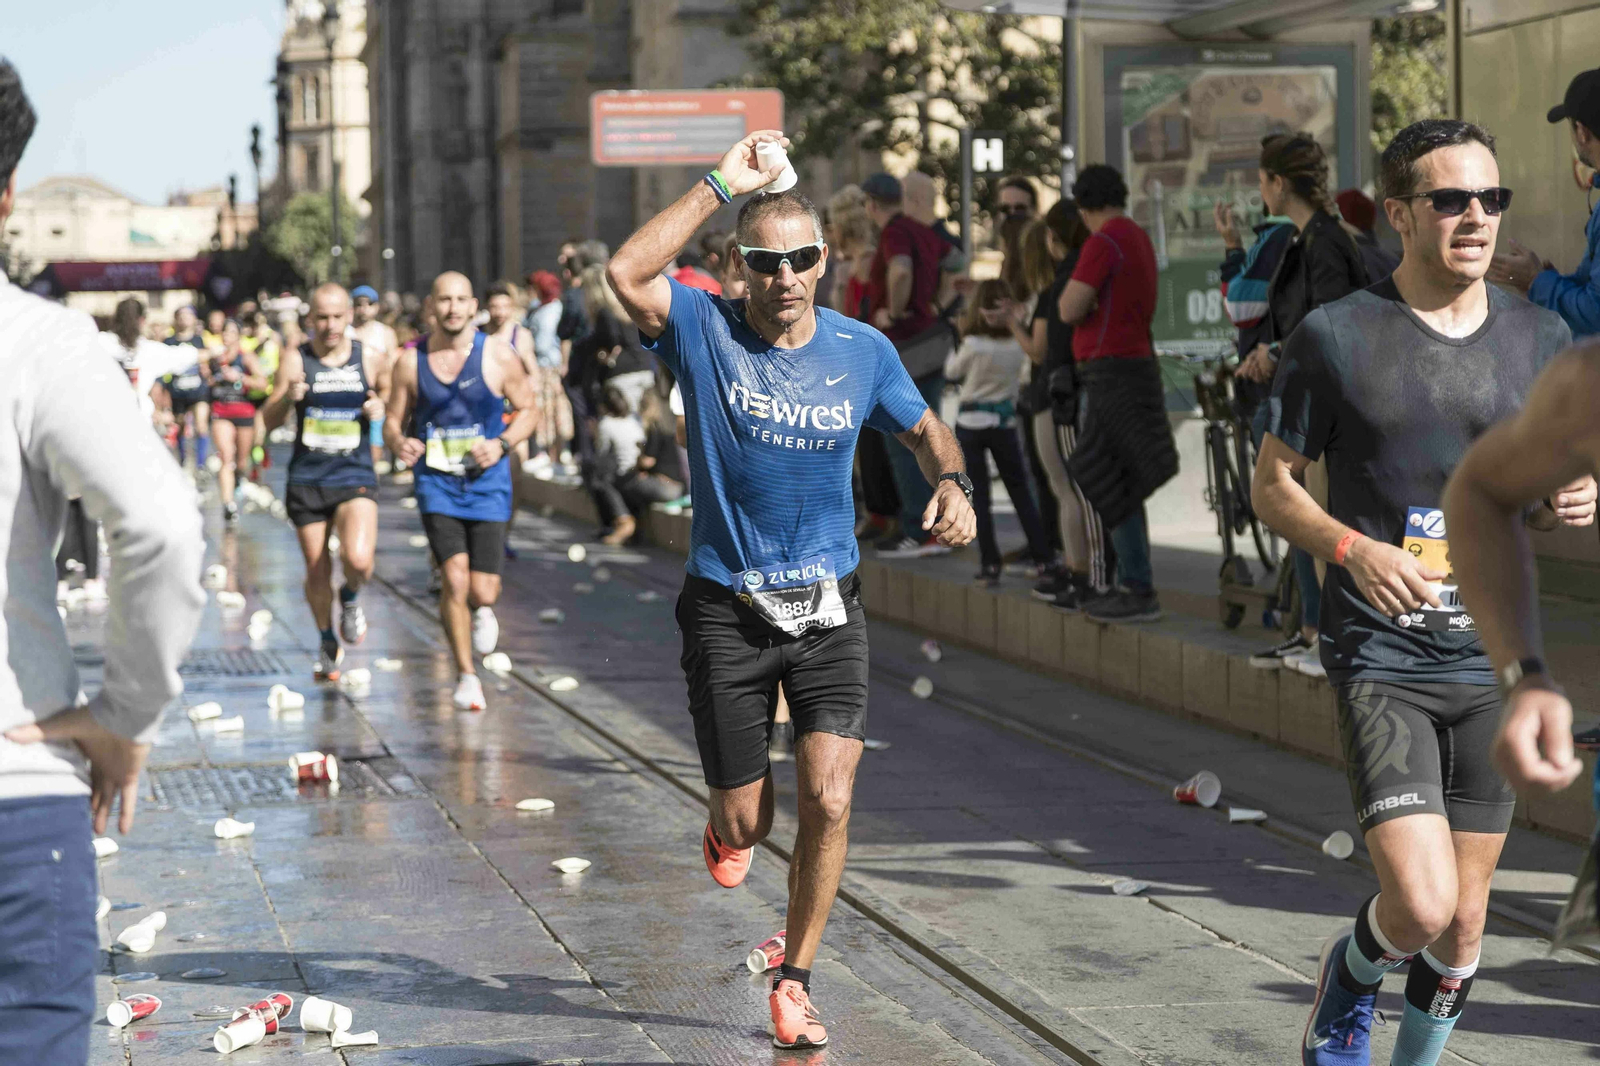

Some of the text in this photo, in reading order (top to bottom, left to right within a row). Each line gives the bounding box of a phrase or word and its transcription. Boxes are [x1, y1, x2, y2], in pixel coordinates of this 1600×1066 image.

[972, 138, 1003, 172] H
[1187, 289, 1222, 324] 08
[751, 424, 836, 450] TENERIFE
[768, 563, 822, 584] ZURICH
[1358, 792, 1427, 824] LURBEL
